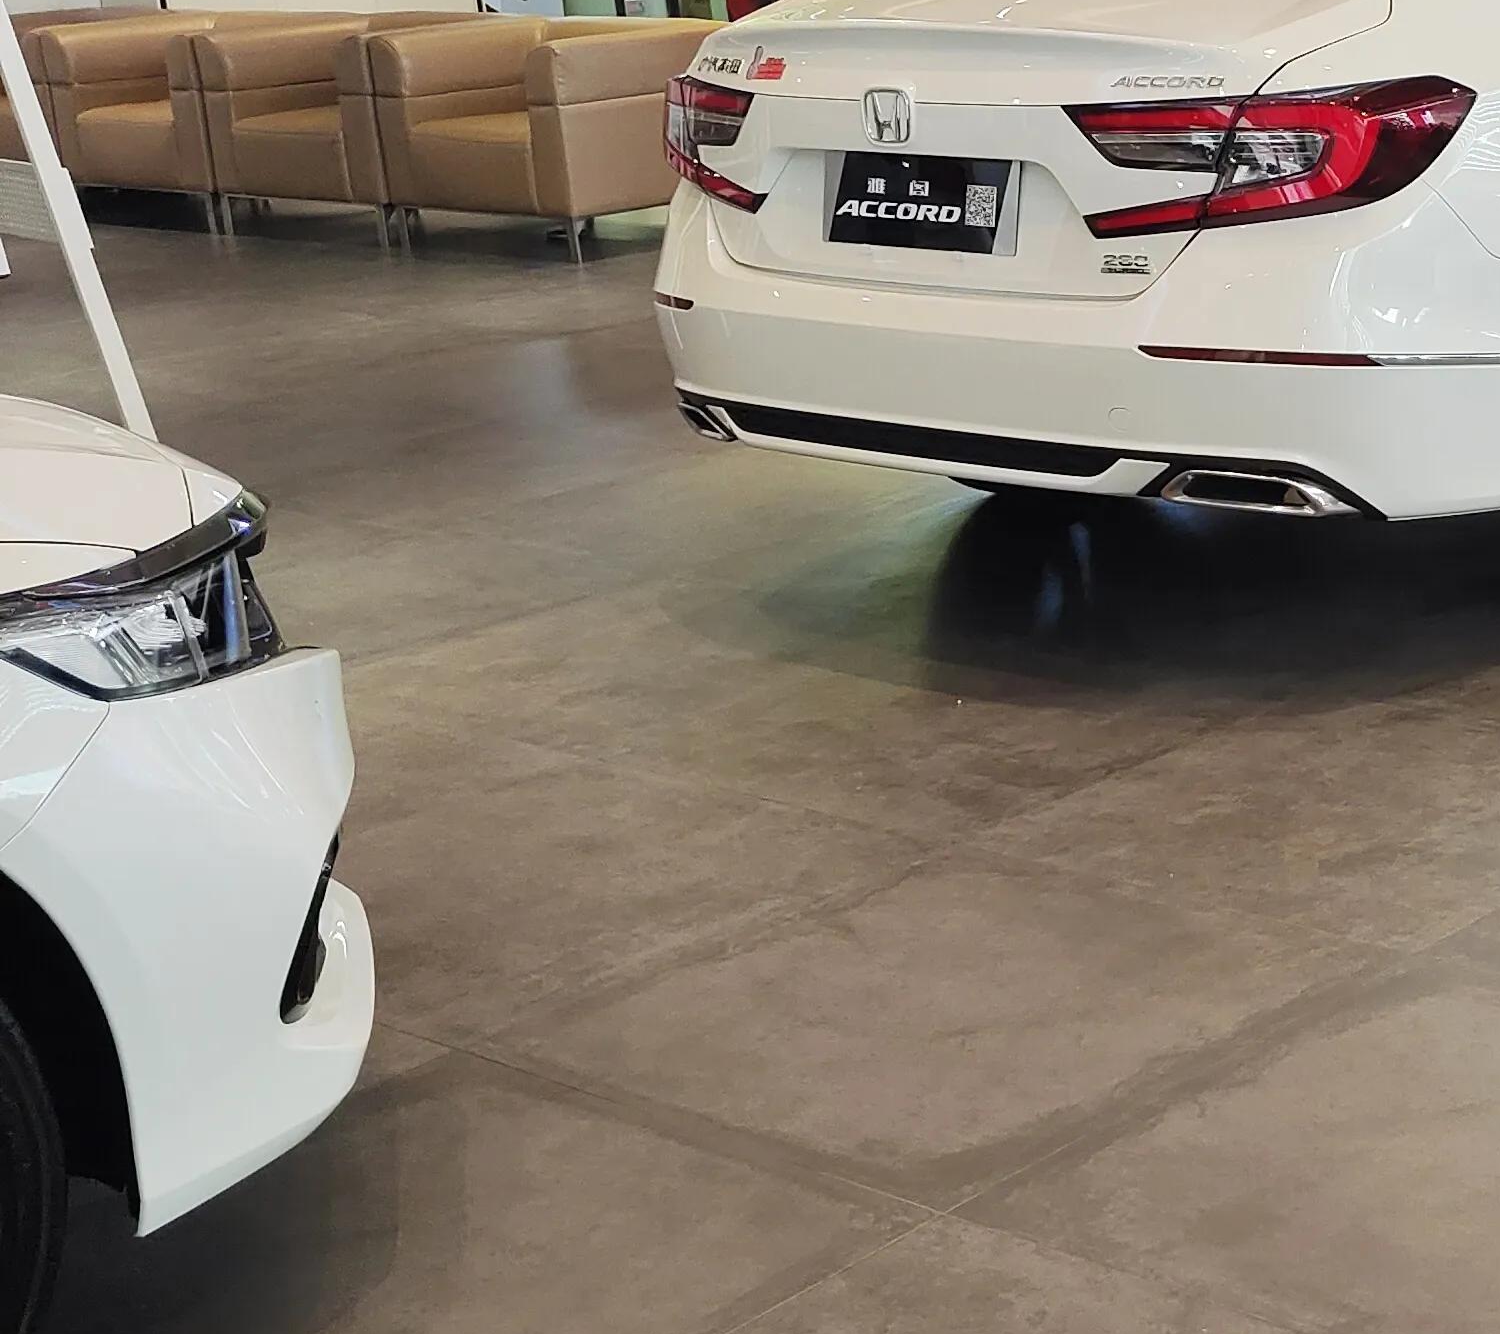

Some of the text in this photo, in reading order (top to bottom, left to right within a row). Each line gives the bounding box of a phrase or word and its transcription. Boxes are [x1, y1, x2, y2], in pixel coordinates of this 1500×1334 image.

[1110, 76, 1224, 88] ACCORD
[867, 177, 929, 197] 雅阁
[836, 200, 961, 223] ACCORD
